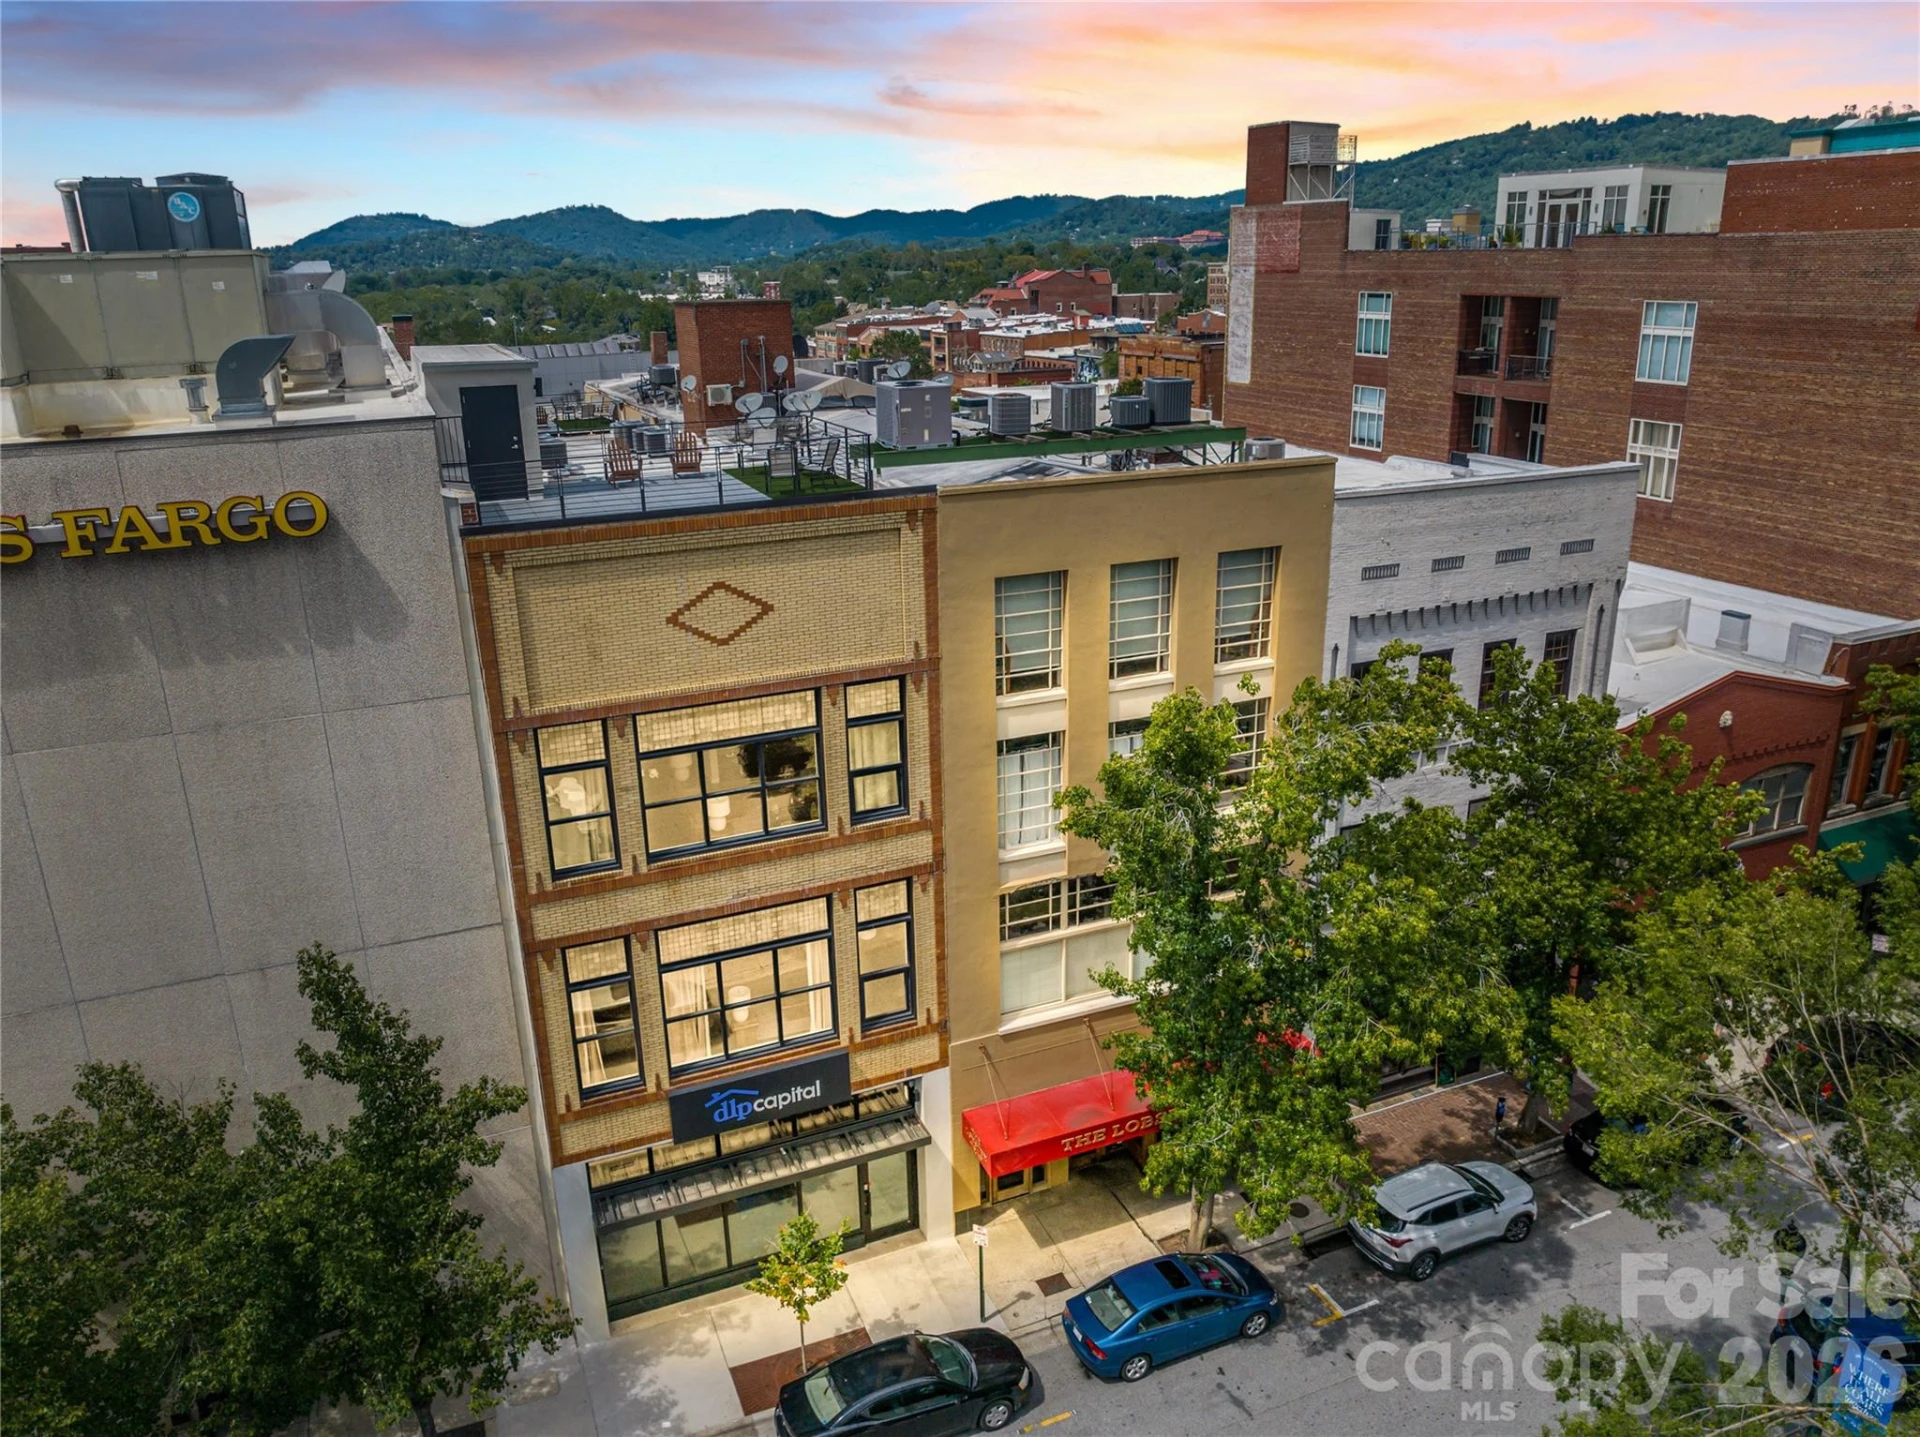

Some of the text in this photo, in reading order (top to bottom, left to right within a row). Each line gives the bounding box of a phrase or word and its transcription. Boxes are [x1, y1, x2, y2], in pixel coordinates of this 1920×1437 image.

[52, 490, 329, 559] FARGO
[1061, 1127, 1107, 1152] THE
[1849, 1363, 1891, 1397] WHERE
[1844, 1383, 1884, 1416] COMES
